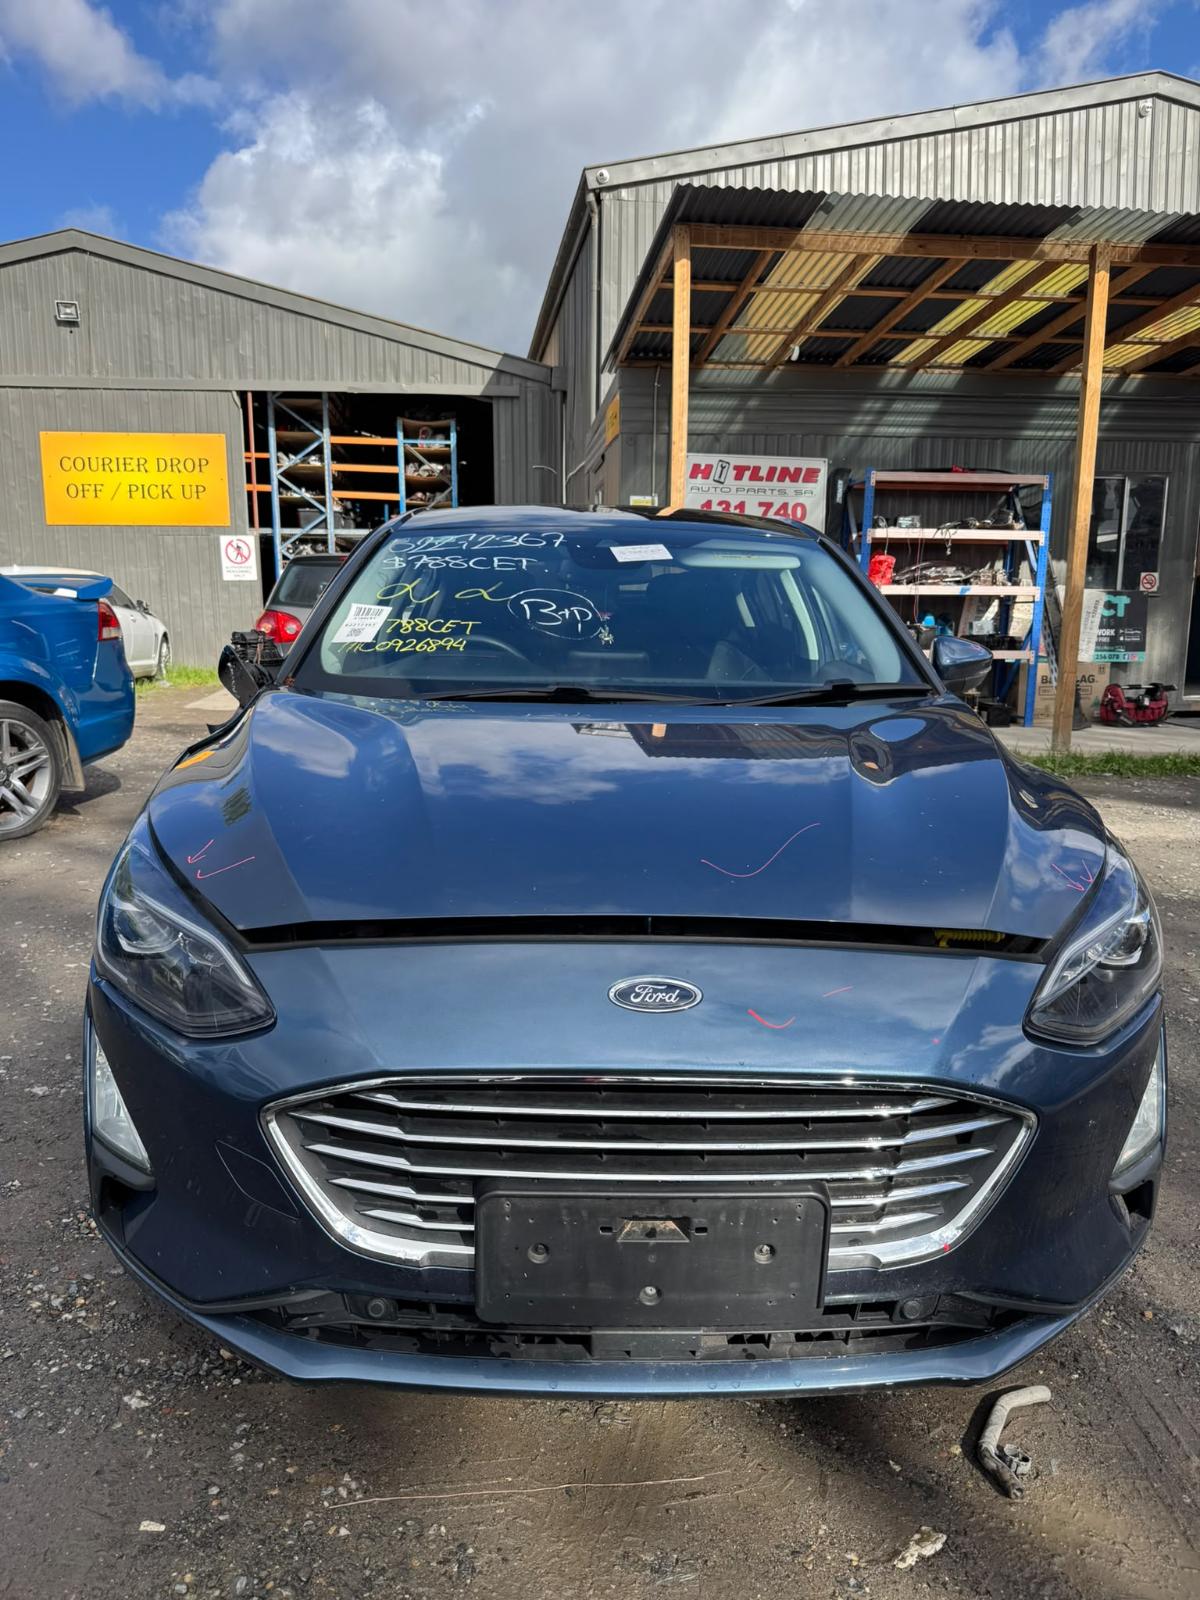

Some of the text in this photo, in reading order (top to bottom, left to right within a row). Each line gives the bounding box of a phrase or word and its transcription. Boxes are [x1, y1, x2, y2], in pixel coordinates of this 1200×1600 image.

[59, 456, 209, 474] COURIER DROP
[66, 482, 207, 501] OFF / PICK UP
[690, 486, 731, 494] AUTO
[758, 501, 808, 522] 740
[630, 984, 681, 1003] Ford
